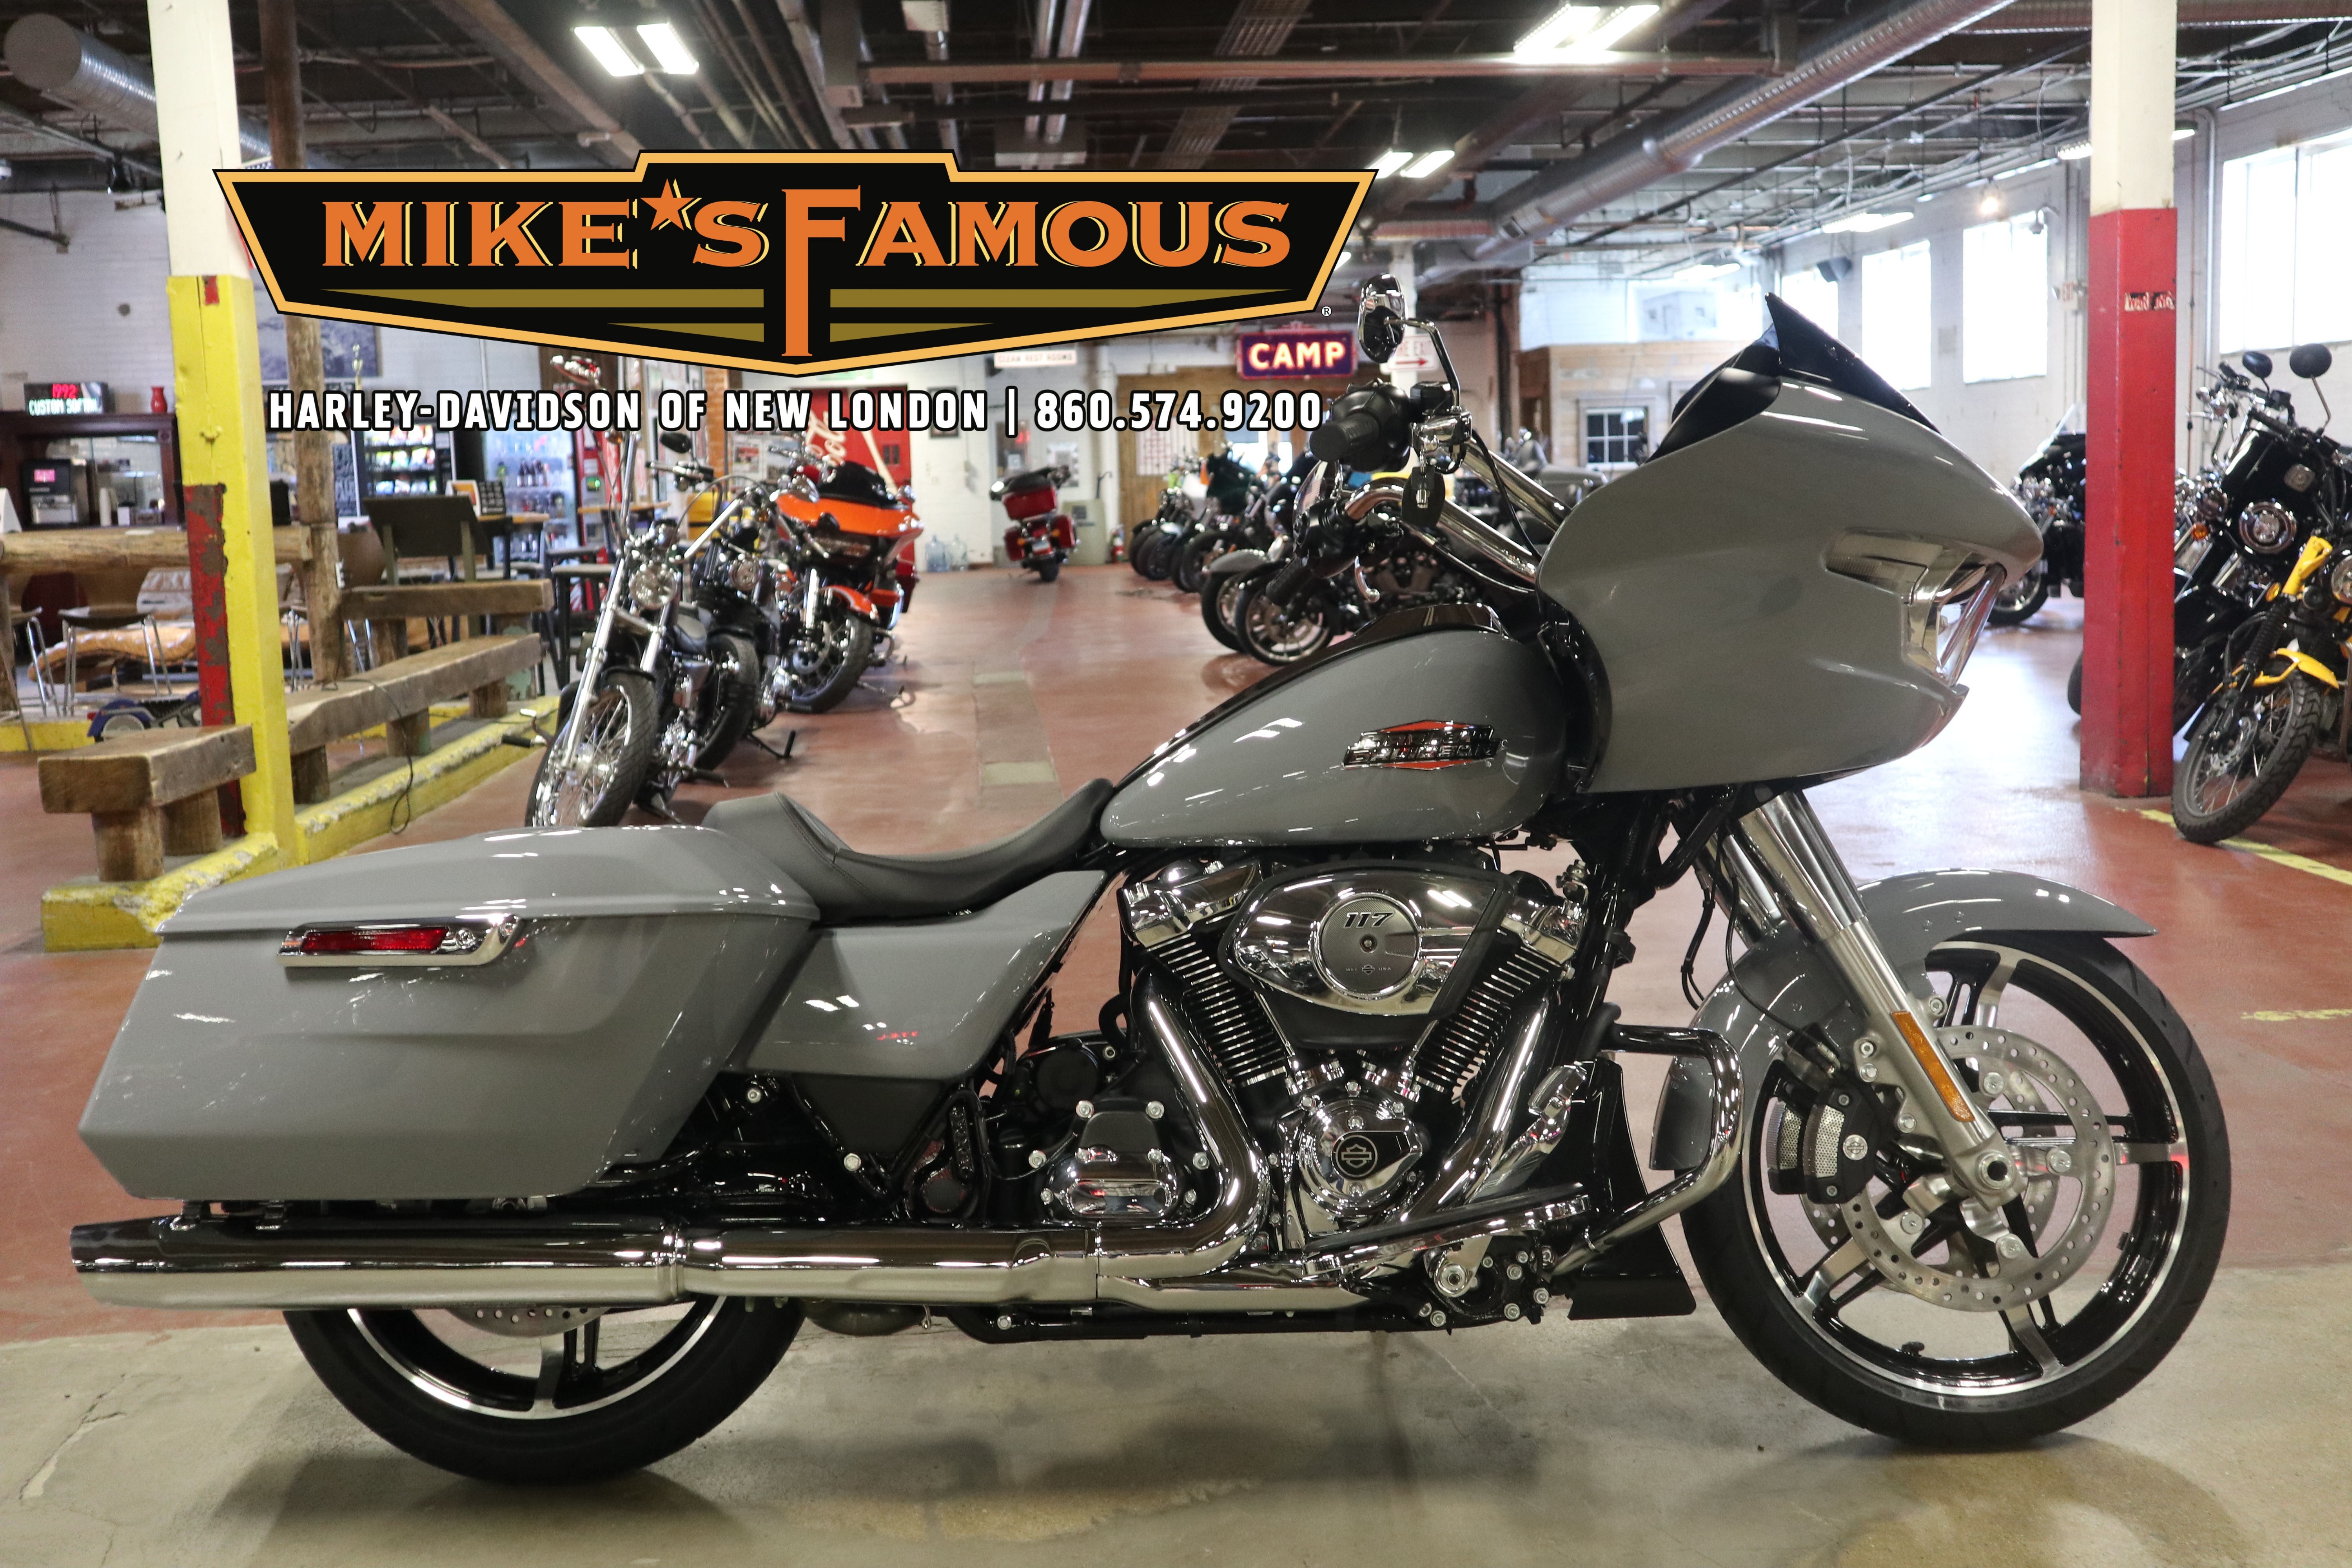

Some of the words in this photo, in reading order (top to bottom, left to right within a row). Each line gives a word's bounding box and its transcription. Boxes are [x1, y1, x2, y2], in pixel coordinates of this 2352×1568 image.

[1248, 340, 1345, 371] CAMP
[52, 383, 78, 399] 1992
[29, 398, 65, 416] CUSTOM
[1344, 911, 1395, 929] 117
